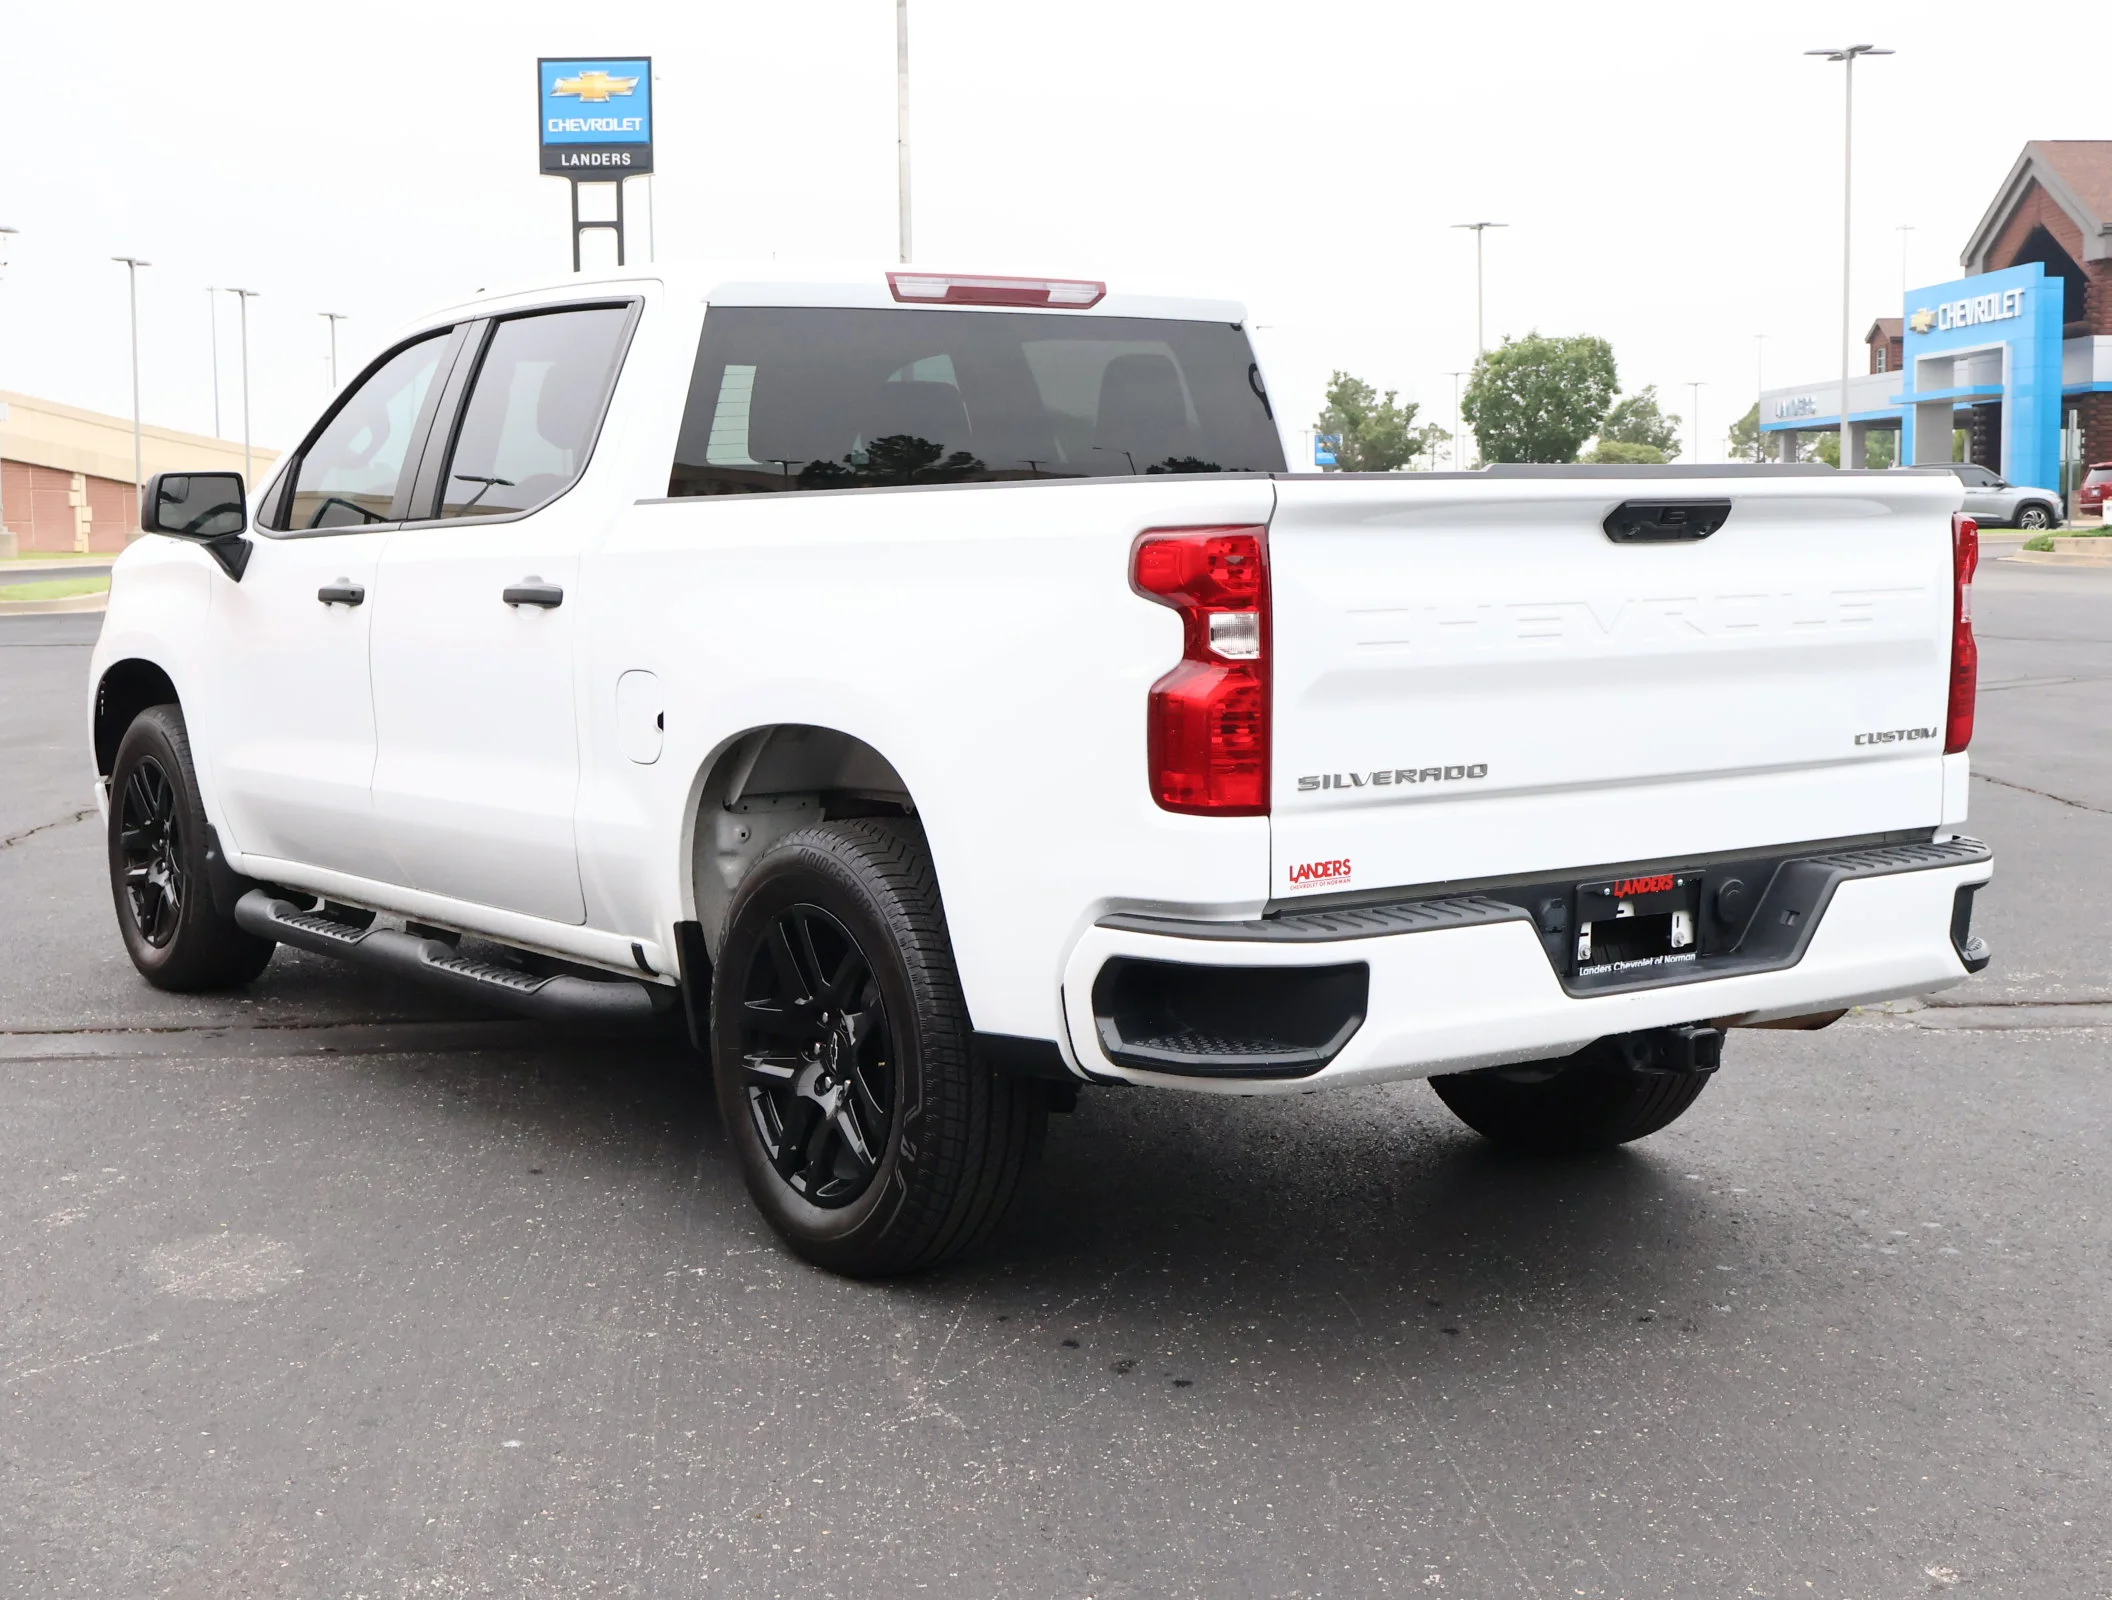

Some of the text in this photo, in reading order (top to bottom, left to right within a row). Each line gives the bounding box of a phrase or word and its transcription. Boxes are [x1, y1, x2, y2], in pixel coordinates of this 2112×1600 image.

[548, 117, 643, 132] CHEVROLET
[561, 153, 631, 166] LANDERS
[1938, 287, 2025, 331] CHEVROLET
[1854, 726, 1938, 745] CUSTOM
[1297, 763, 1488, 791] SILVERADO
[1289, 858, 1352, 883] LANDERS
[1614, 873, 1675, 898] LANDERS
[1579, 965, 1612, 976] Landers
[1664, 953, 1696, 964] Norman
